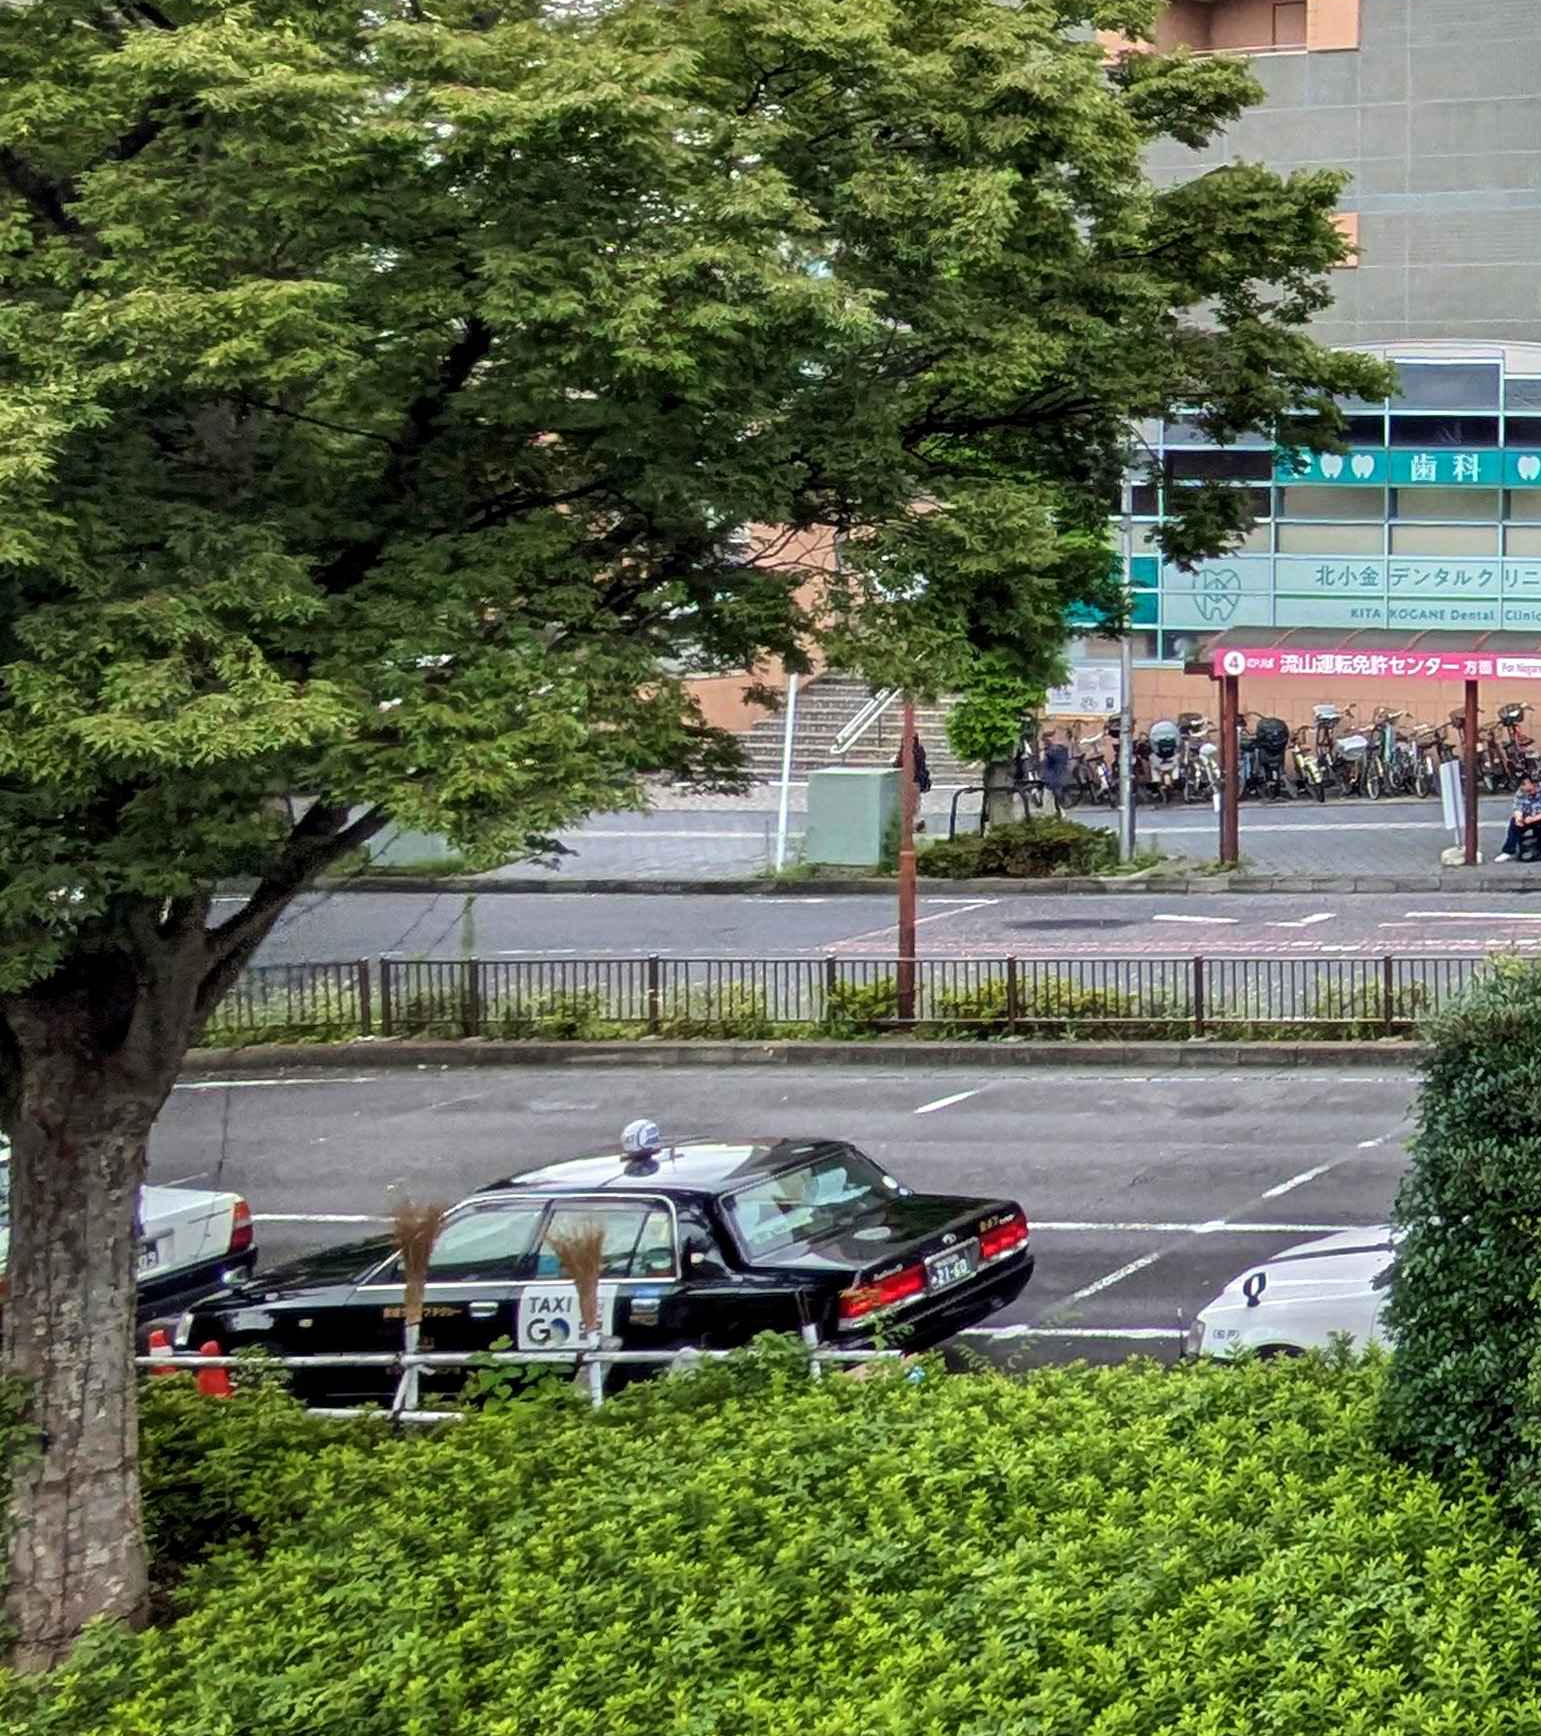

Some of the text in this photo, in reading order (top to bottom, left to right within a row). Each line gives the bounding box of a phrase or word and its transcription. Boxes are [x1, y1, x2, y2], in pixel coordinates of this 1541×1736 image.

[1411, 453, 1480, 482] 歯科
[1451, 609, 1495, 622] Dental
[1280, 654, 1459, 676] 流山運転免許センター
[528, 1296, 573, 1313] TAXI
